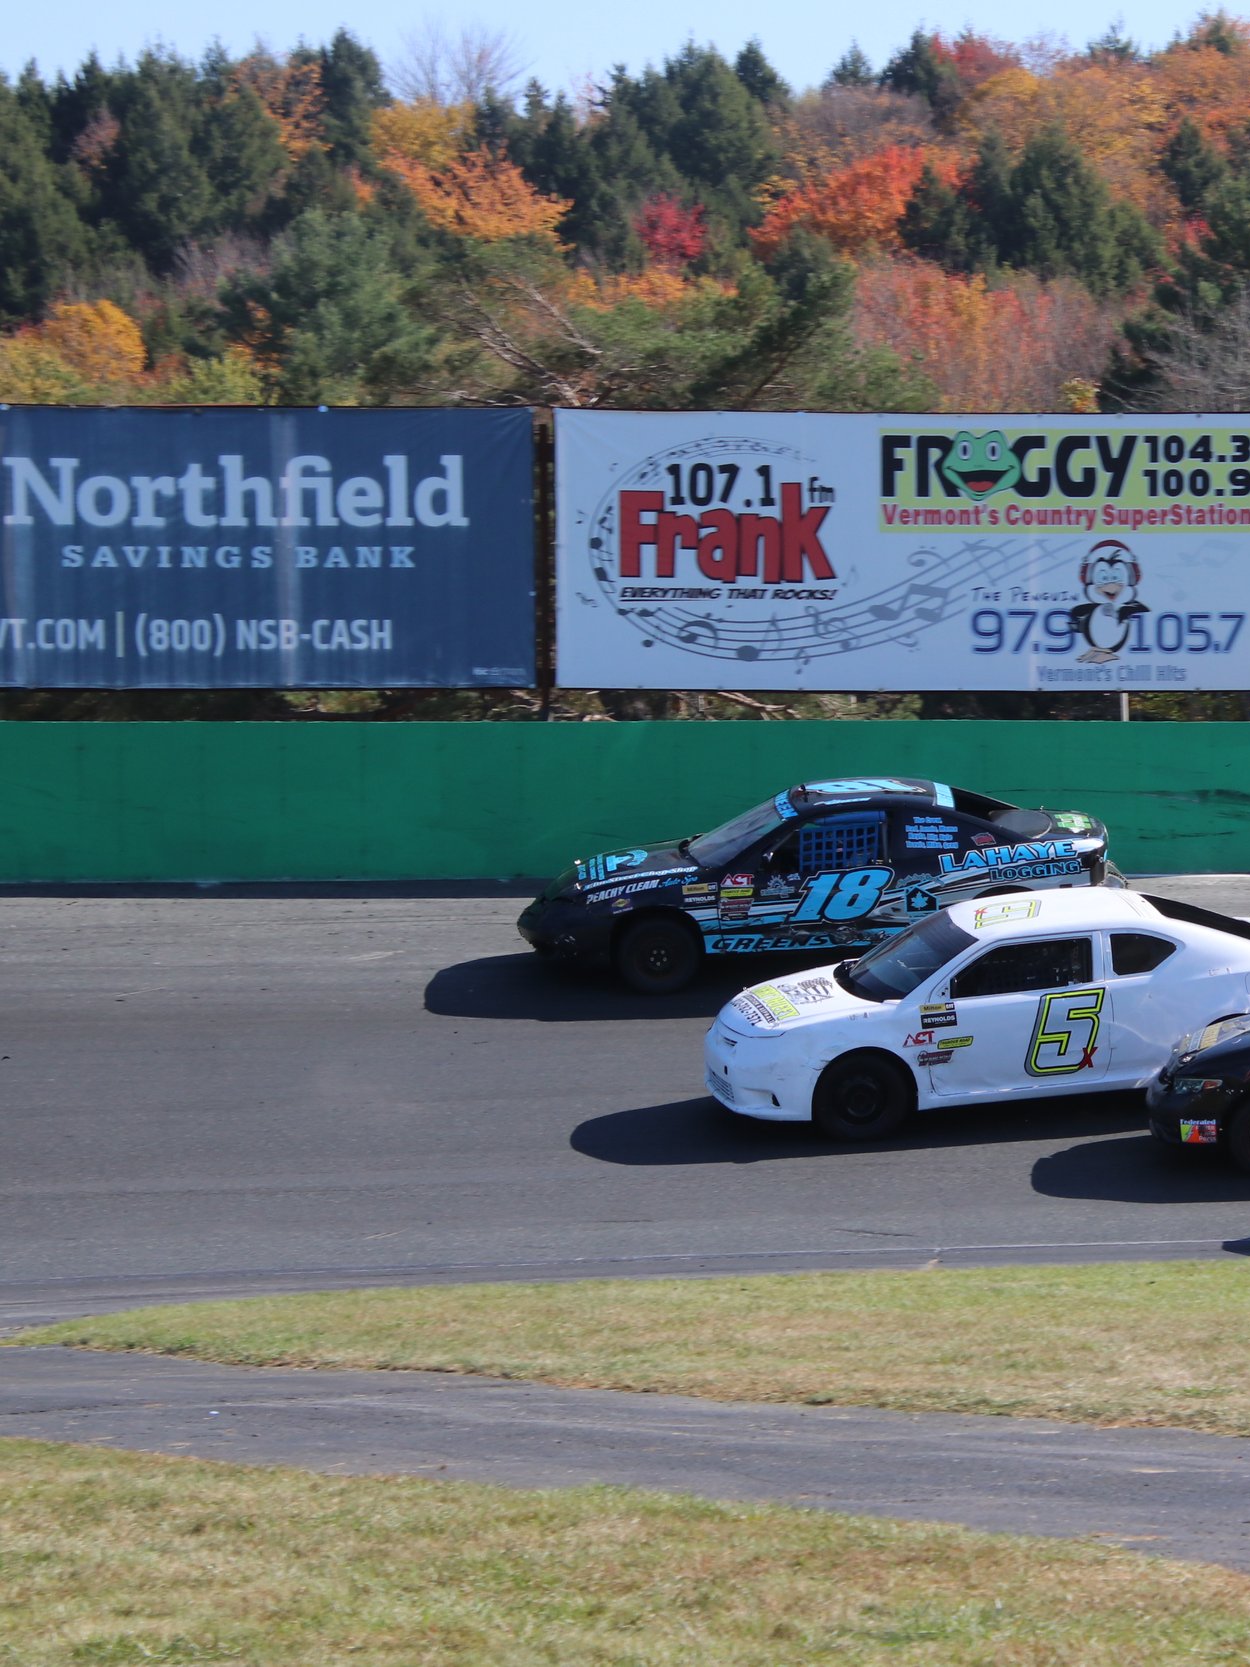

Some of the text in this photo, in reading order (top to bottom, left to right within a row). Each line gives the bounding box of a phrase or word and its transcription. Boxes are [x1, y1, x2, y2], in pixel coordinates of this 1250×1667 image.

[881, 432, 1138, 499] FRGGY
[2, 455, 470, 527] Northfield
[665, 463, 776, 506] 107.1
[882, 503, 1000, 527] Vermont's
[1004, 503, 1097, 531] Country
[618, 482, 837, 584] Frank
[62, 545, 417, 569] SAVINGS BANK
[619, 586, 838, 602] EVERYTHING THAT ROCKS!
[135, 613, 226, 657] (800)
[236, 618, 392, 652] NSB-CASH
[972, 608, 1247, 656] 97.9 105.7
[1037, 664, 1187, 683] Vermont's Chill Hits
[938, 840, 1078, 874] LAHAYE
[990, 858, 1082, 882] LOGGING
[586, 886, 625, 905] PEACHY
[625, 879, 660, 894] CLEAN
[684, 895, 716, 903] REYNOLDS
[790, 867, 896, 924] 18
[923, 1014, 956, 1024] REYNOLDS
[1025, 988, 1106, 1077] 5
[903, 1030, 936, 1048] ACT
